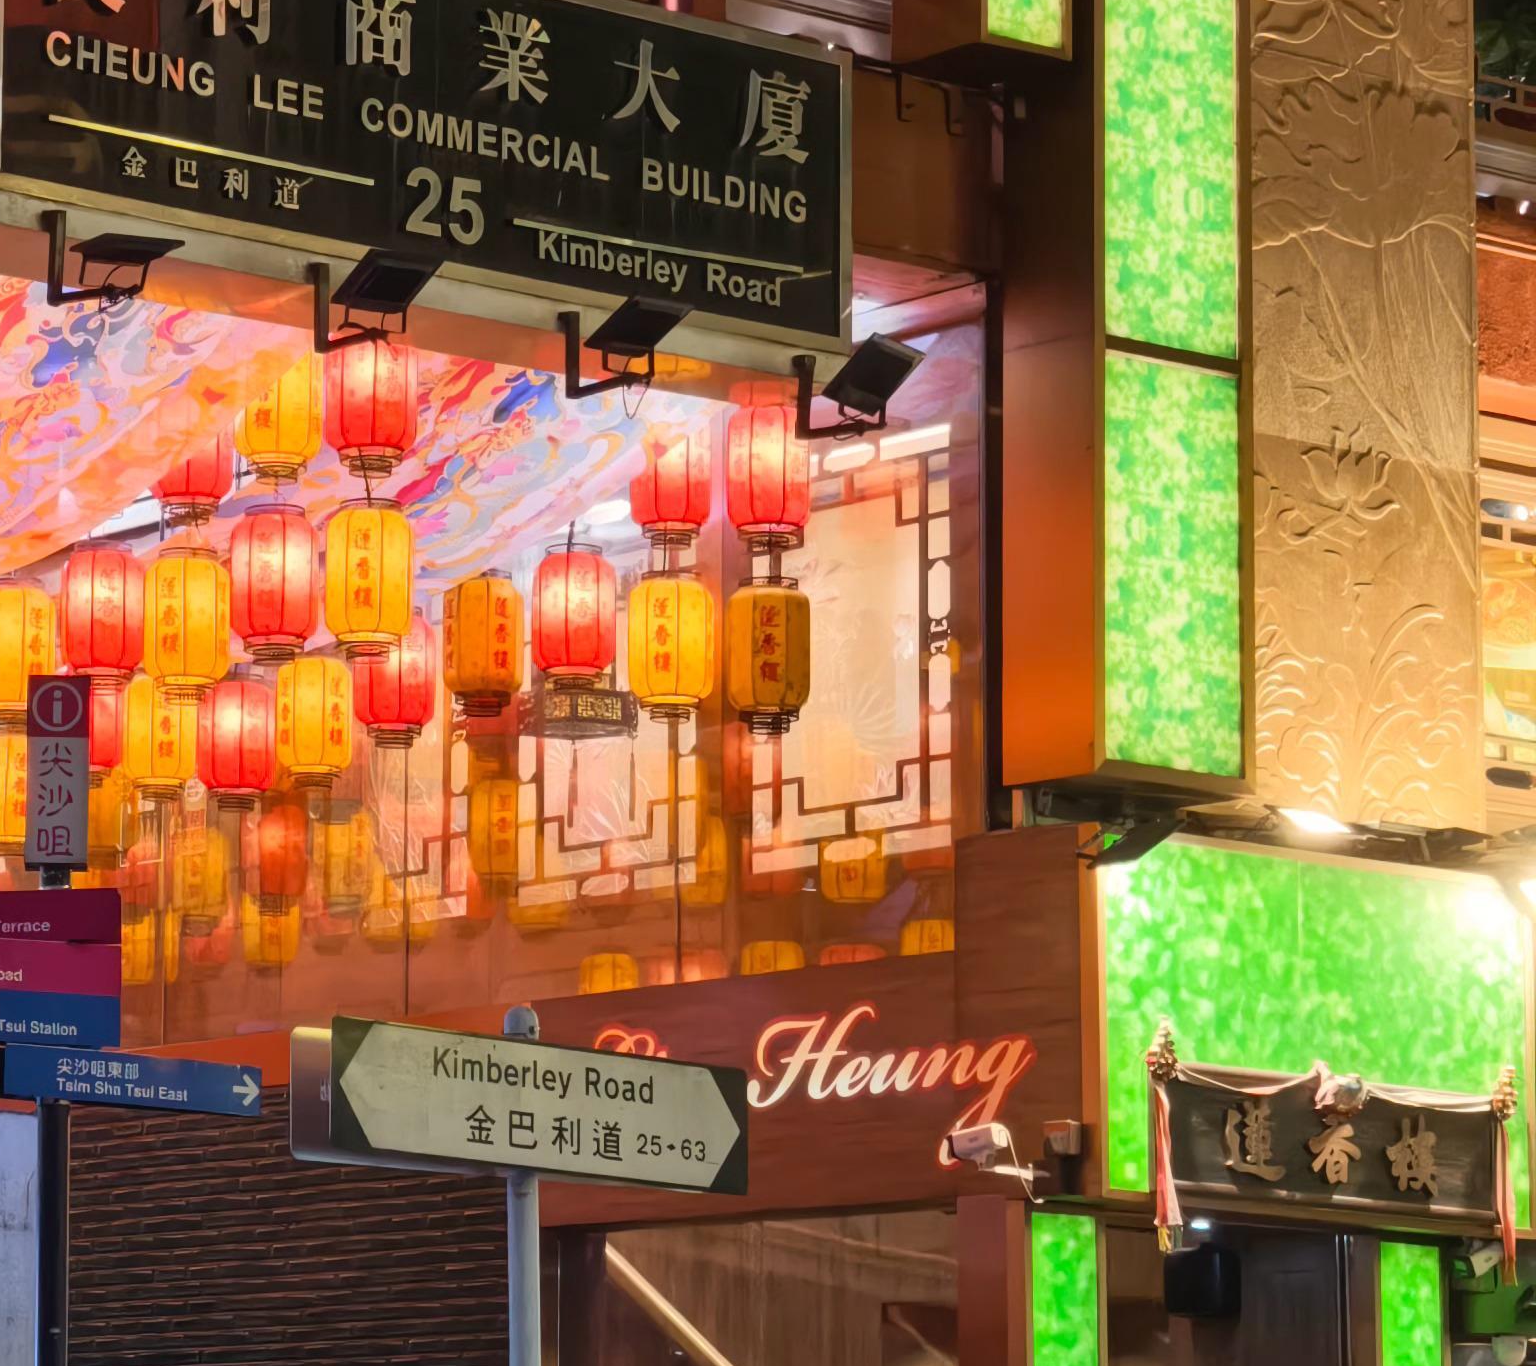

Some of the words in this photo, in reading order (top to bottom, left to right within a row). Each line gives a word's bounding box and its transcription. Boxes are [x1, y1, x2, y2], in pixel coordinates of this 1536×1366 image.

[46, 31, 215, 96] CHEUNG
[254, 74, 324, 121] LEE
[361, 97, 611, 182] COMMERCIAL
[641, 158, 807, 223] BUILDING
[121, 146, 304, 210] 金巴利道
[405, 166, 485, 246] 25
[538, 229, 688, 293] Kimberley
[706, 262, 782, 307] Road
[36, 743, 75, 858] 尖沙咀
[30, 1020, 77, 1036] Station
[56, 1058, 140, 1080] 尖沙咀東部
[56, 1077, 91, 1094] Tsim
[94, 1080, 121, 1096] Sha
[125, 1083, 154, 1099] Tsui
[158, 1086, 188, 1102] East
[432, 1045, 573, 1100] Kimberley
[584, 1067, 655, 1106] Road
[747, 1005, 1033, 1167] Heung
[464, 1103, 624, 1162] 金巴利道
